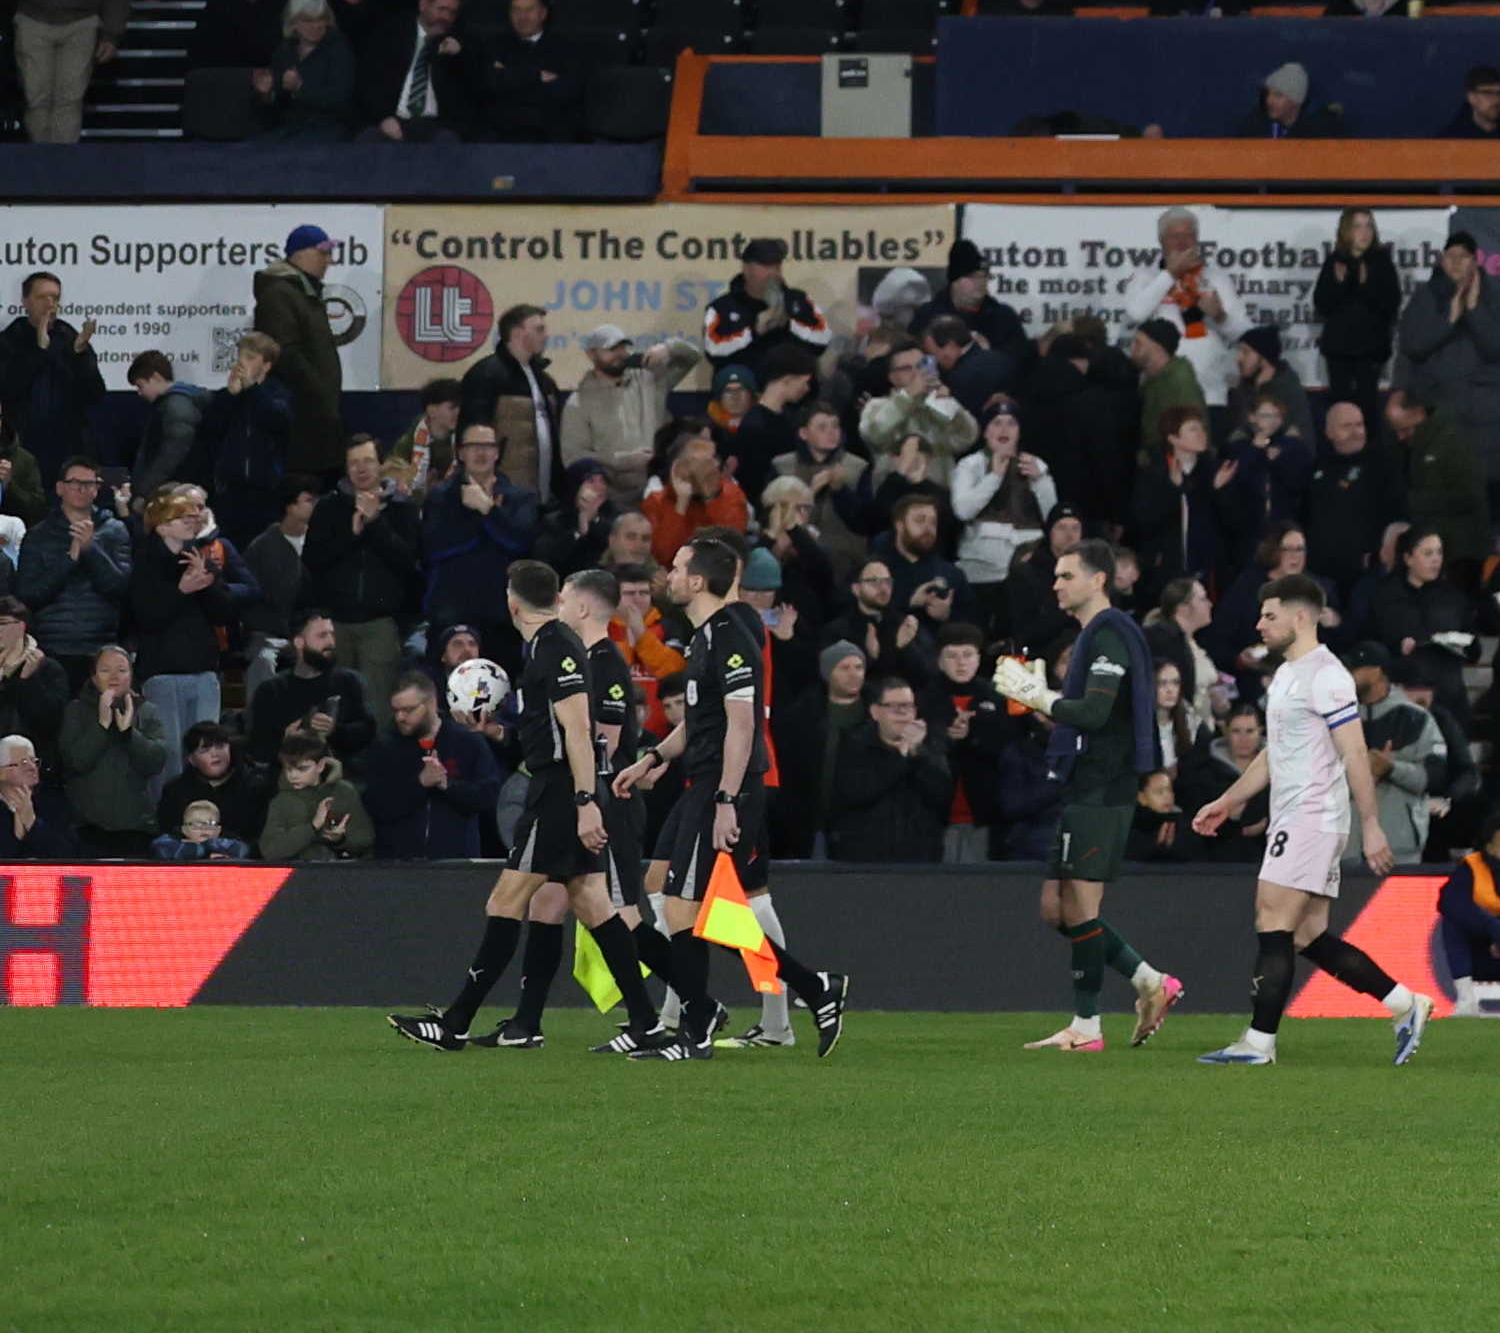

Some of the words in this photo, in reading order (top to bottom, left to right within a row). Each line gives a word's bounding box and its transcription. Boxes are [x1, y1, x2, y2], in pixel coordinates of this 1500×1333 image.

[1, 236, 77, 265] uton
[391, 229, 562, 261] “Control
[575, 229, 646, 260] The
[1081, 241, 1175, 268] Tow
[546, 280, 661, 312] JOHN
[1040, 276, 1107, 294] most
[156, 303, 247, 319] supporters
[1043, 302, 1125, 323] histor
[133, 322, 171, 336] 1990
[1270, 831, 1288, 857] 8
